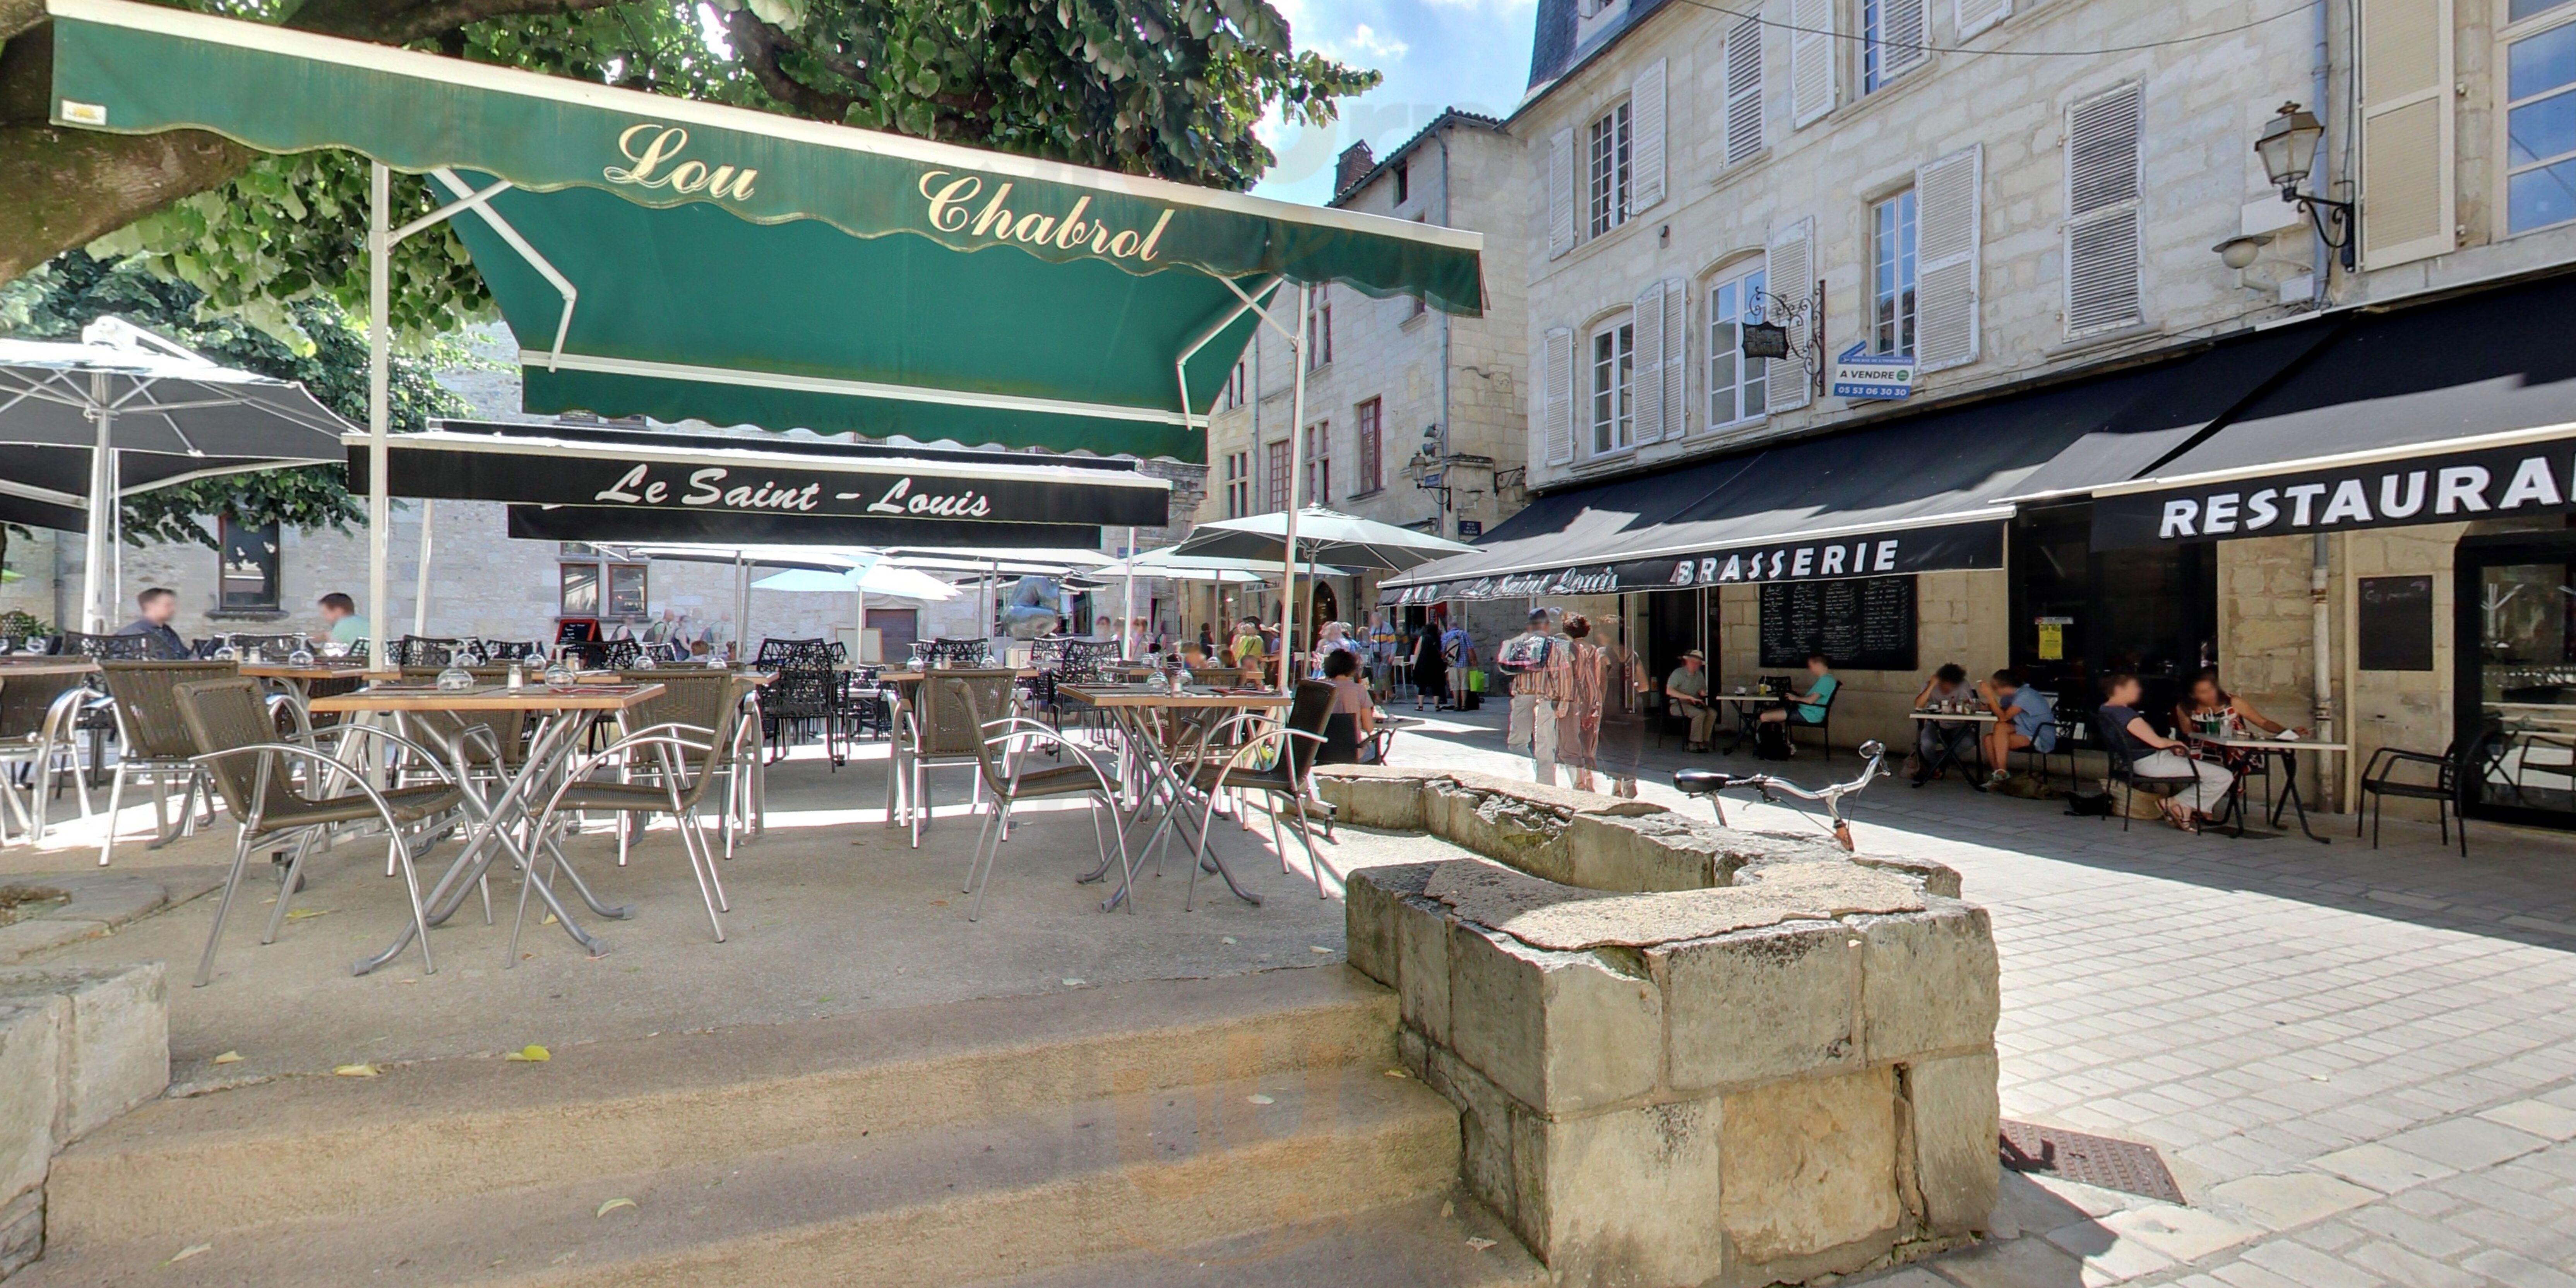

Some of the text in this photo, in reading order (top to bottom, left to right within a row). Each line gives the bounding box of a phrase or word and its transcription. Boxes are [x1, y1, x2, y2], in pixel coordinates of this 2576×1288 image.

[602, 123, 1175, 262] Lou Chabrol
[1851, 370, 1895, 379] VENDRE
[595, 464, 669, 503] Le
[682, 468, 820, 511] Saint
[867, 476, 991, 517] Louis
[2159, 453, 2576, 538] RESTAURA
[1398, 539, 1898, 604] BAR Le Saint Louis BRASSERIE
